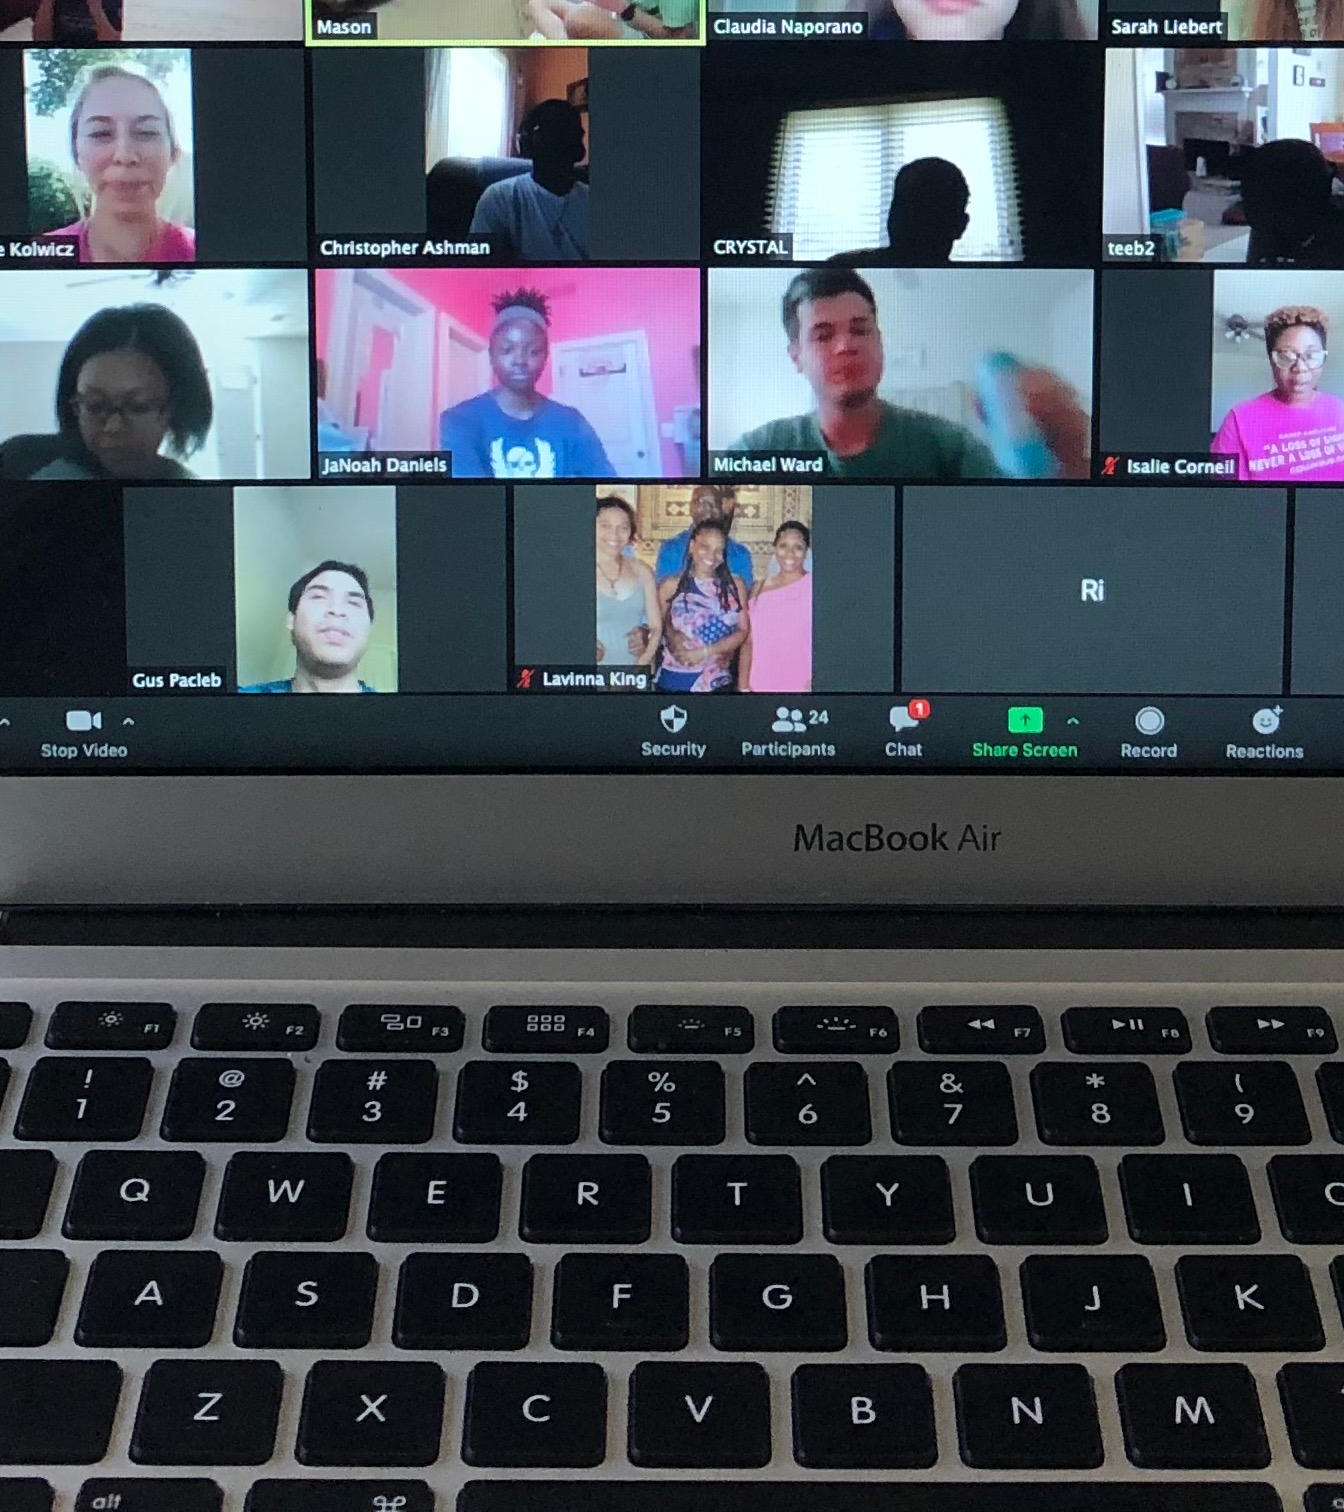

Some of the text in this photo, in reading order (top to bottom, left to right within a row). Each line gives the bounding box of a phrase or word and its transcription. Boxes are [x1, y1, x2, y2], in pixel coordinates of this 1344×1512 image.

[317, 19, 372, 35] Mason
[713, 18, 863, 37] Claudia Naporano
[1111, 18, 1224, 35] Sarah Liebert
[9, 241, 75, 257] Kolwicz
[320, 239, 491, 258] Christopher Ashman
[713, 239, 789, 255] CRYSTAL
[1107, 240, 1155, 256] teeb2
[321, 456, 448, 476] JaNoah Daniels
[713, 456, 823, 472] Michael Ward
[1127, 458, 1235, 475] Isalie Corneil
[1081, 578, 1105, 602] Ri
[132, 673, 165, 688] Gus
[543, 671, 647, 690] Lavinna King
[808, 709, 829, 725] 24
[41, 742, 128, 760] Stop Video
[641, 740, 707, 759] Security
[741, 741, 836, 759] Participants
[885, 741, 923, 757] Chat
[972, 742, 1078, 758] Share Screen
[1121, 743, 1178, 758] Record
[1226, 743, 1304, 759] Reactions
[793, 822, 1003, 852] MacBook Air
[119, 1178, 150, 1202] Q
[268, 1179, 305, 1203] W
[427, 1180, 447, 1205] E
[577, 1181, 599, 1206] R
[726, 1182, 748, 1206] T
[875, 1182, 900, 1207] Y
[1025, 1182, 1054, 1207] U
[1182, 1182, 1193, 1207] I
[193, 1392, 223, 1421] Z
[355, 1394, 388, 1422] X
[522, 1394, 551, 1422] C
[684, 1394, 713, 1423] V
[850, 1396, 877, 1425] B
[1011, 1396, 1043, 1425] N
[1175, 1395, 1215, 1425] M
[91, 1492, 122, 1511] alt
